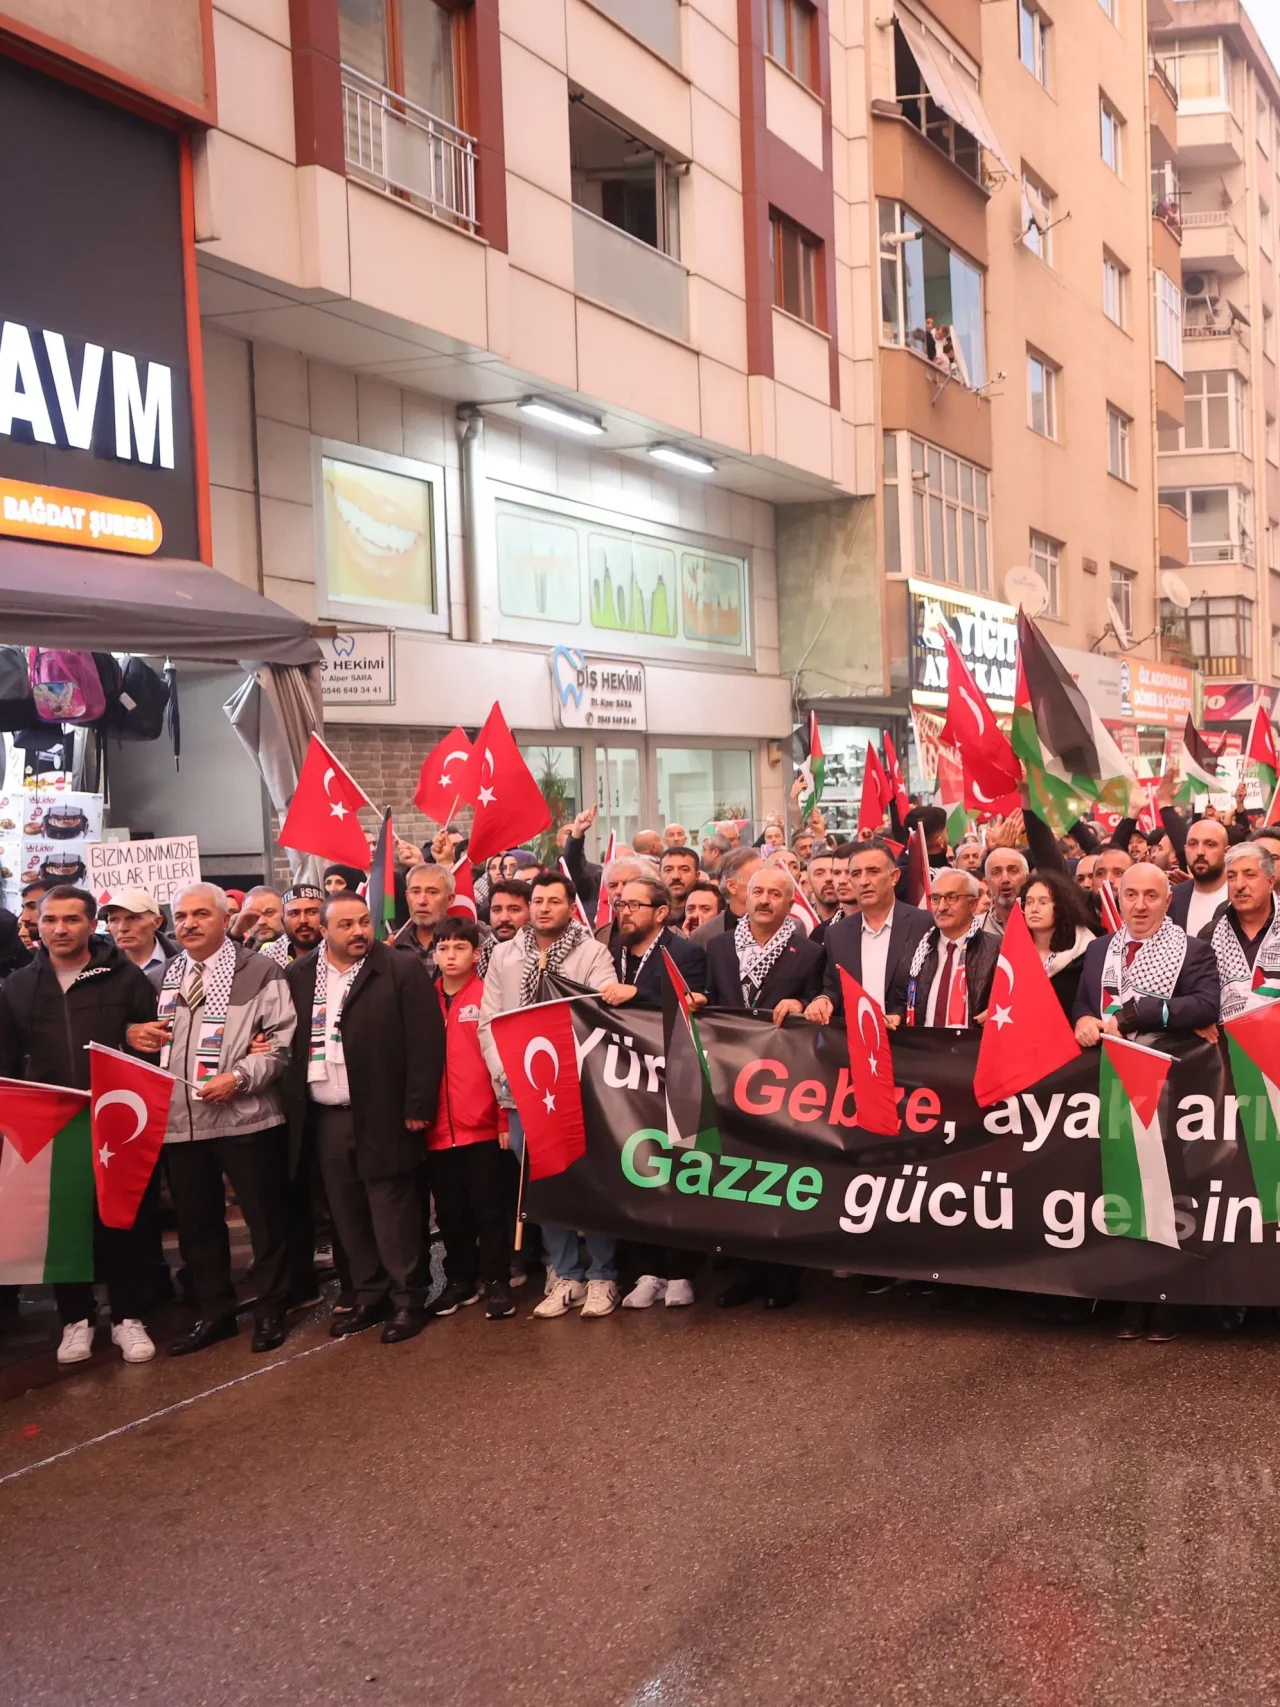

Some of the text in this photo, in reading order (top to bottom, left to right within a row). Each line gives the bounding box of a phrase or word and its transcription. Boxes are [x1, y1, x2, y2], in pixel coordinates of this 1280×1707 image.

[0, 321, 174, 469] AVM
[3, 496, 154, 540] BAĞDAT ŞUBESİ
[334, 657, 384, 670] HEKİMİ
[577, 665, 642, 693] DİŞ HEKİMİ
[91, 841, 196, 868] BİZİM DİNİMİZDE
[92, 860, 194, 888] KUŞLAR FİLLERİ
[734, 1058, 957, 1144] Gebe,
[621, 1128, 823, 1211] Gazze
[838, 1164, 1014, 1234] gücü
